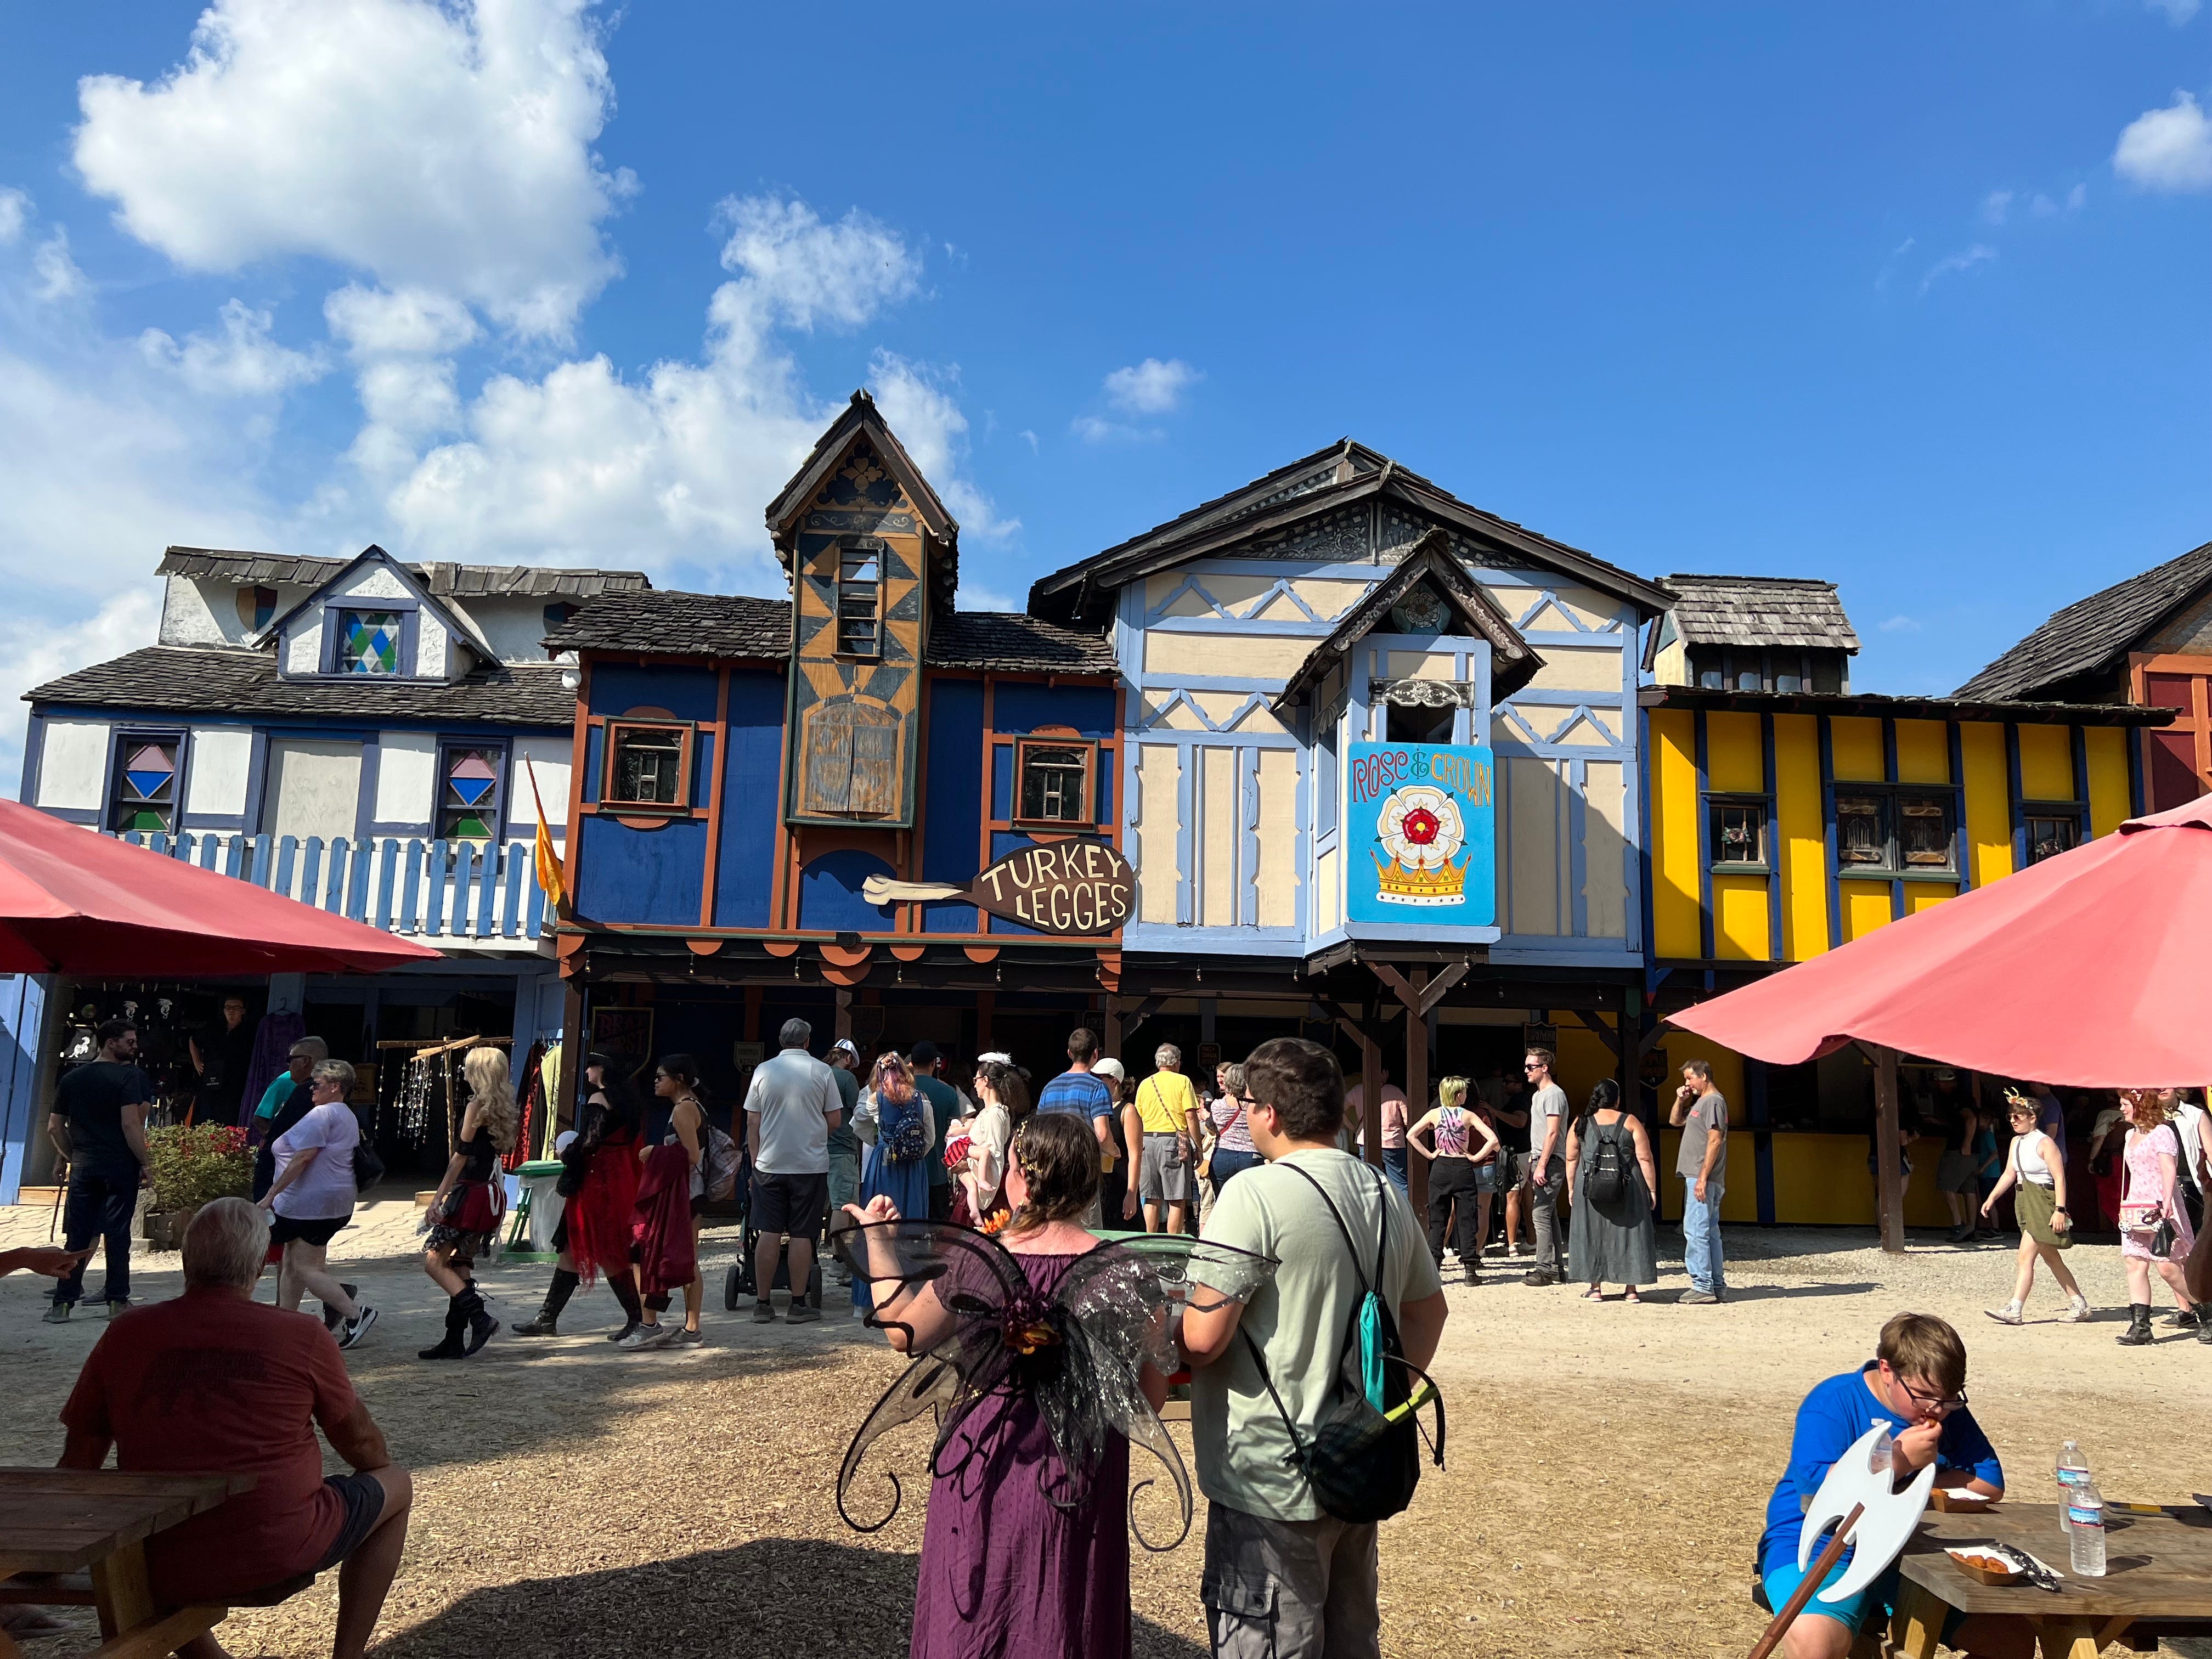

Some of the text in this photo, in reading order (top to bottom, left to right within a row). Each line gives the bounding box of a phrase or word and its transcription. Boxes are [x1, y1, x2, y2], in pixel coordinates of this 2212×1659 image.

[1352, 751, 1408, 803] ROSE
[1431, 753, 1491, 807] CROWN
[981, 843, 1123, 902] TURKEY
[1015, 882, 1129, 930] LEGGES
